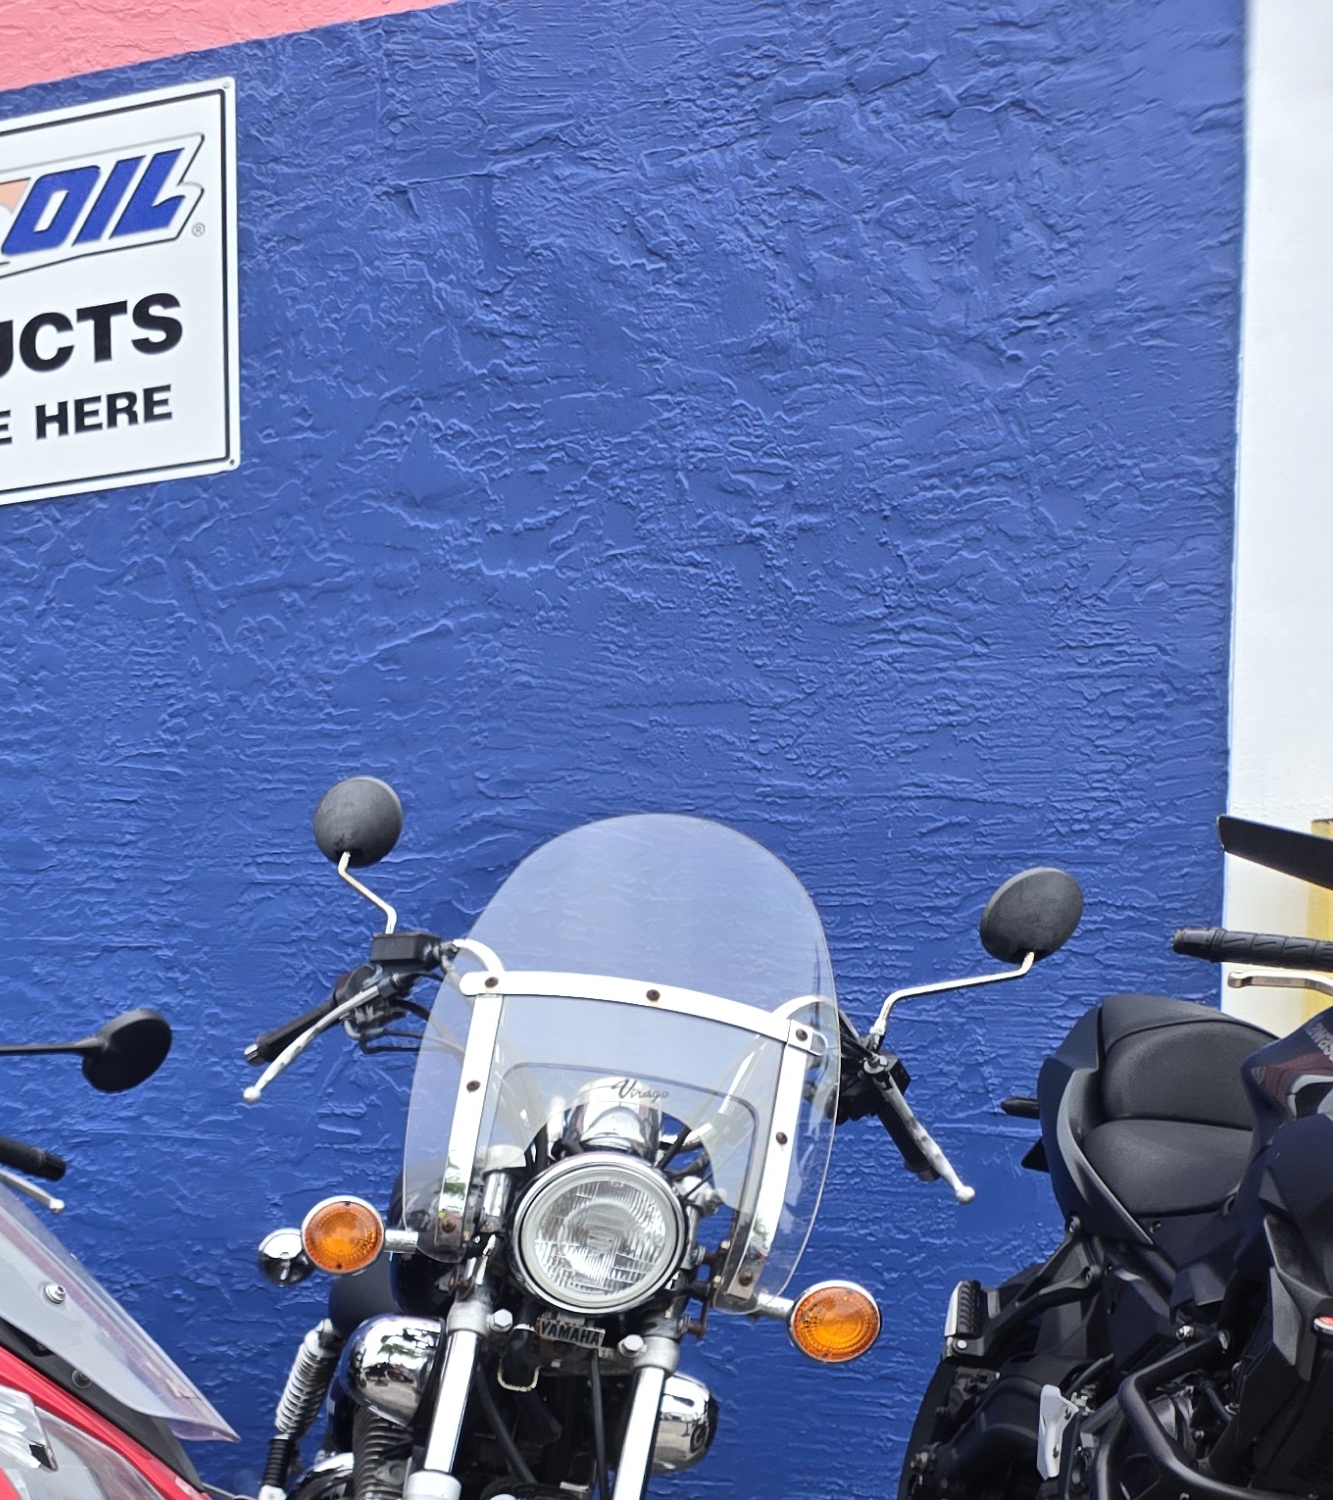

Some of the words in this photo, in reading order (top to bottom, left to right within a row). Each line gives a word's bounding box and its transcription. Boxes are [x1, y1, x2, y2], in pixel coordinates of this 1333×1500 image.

[35, 384, 174, 440] HERE
[611, 1078, 670, 1101] Virago
[539, 1317, 603, 1347] YAMAHA
